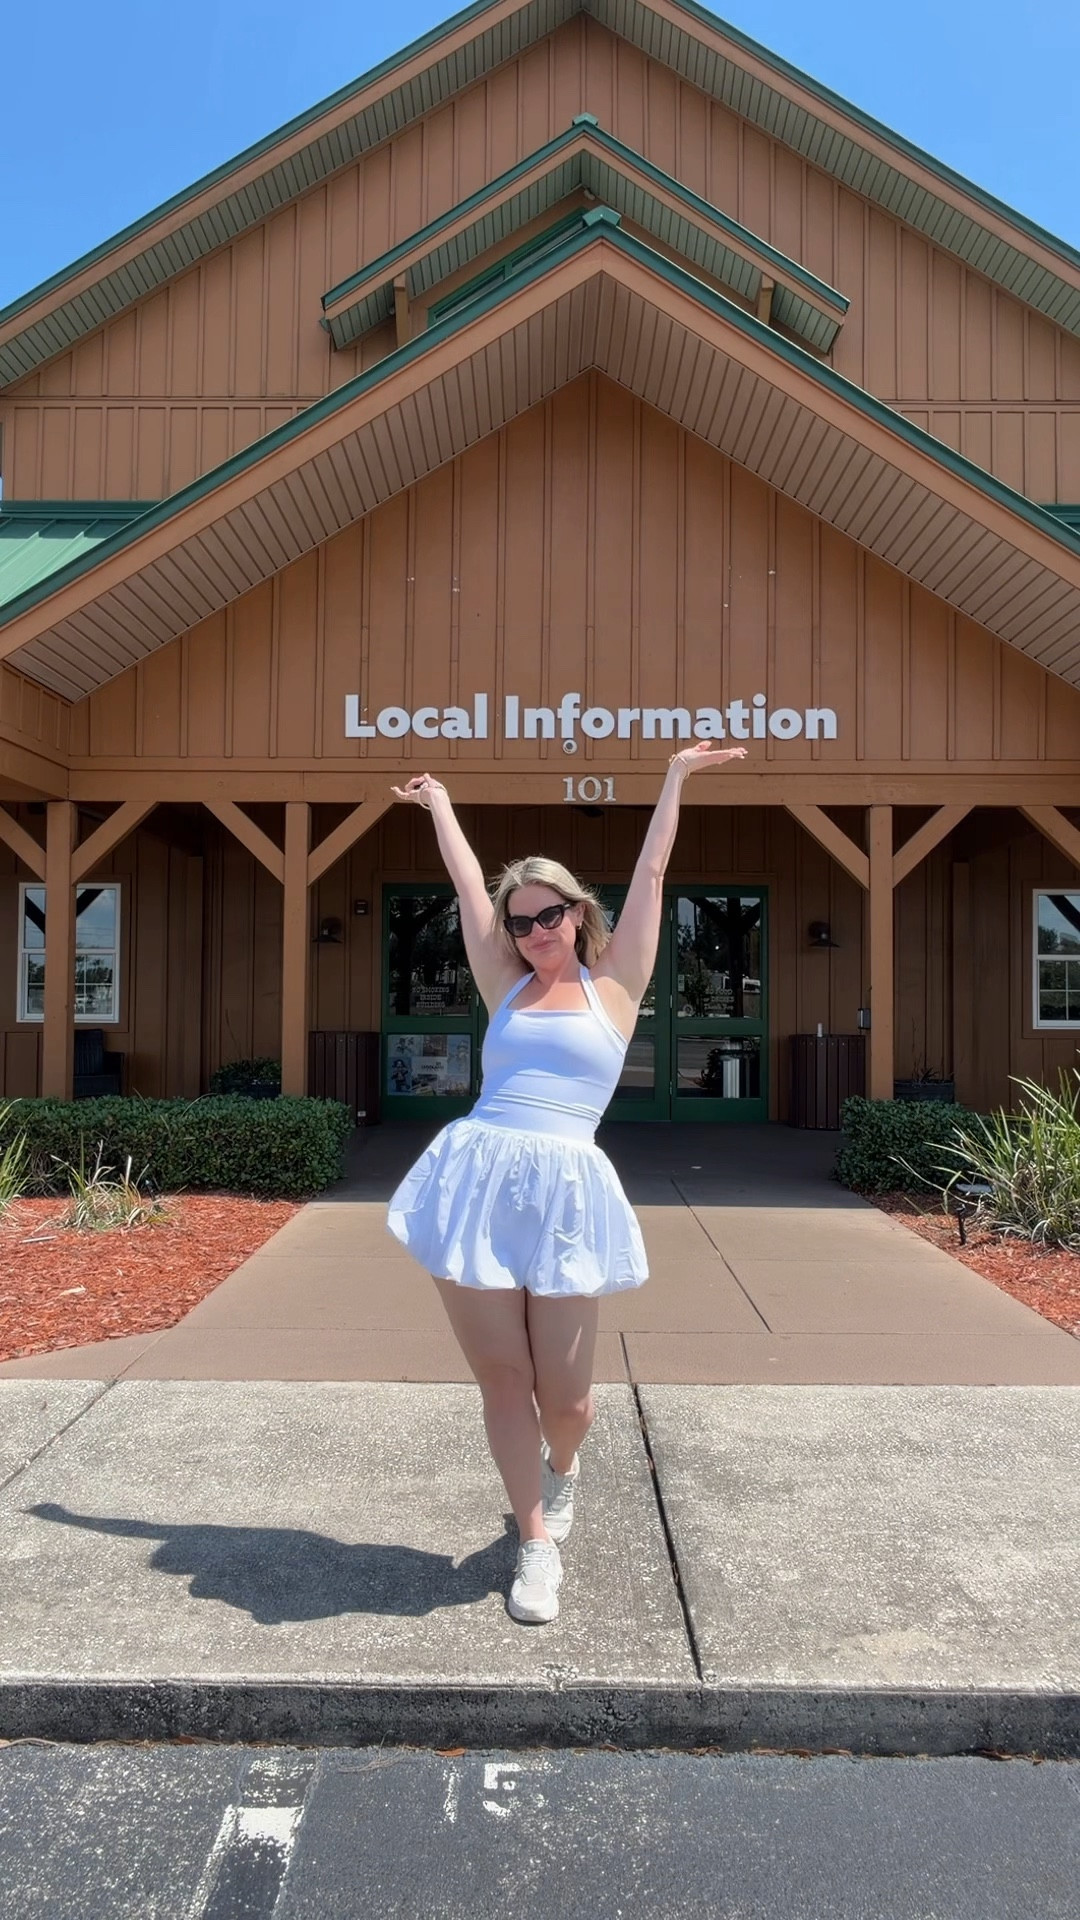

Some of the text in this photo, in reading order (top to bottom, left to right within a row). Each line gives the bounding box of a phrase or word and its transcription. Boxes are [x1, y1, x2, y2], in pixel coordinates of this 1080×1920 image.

[344, 692, 837, 741] Local Information
[562, 776, 617, 803] 101
